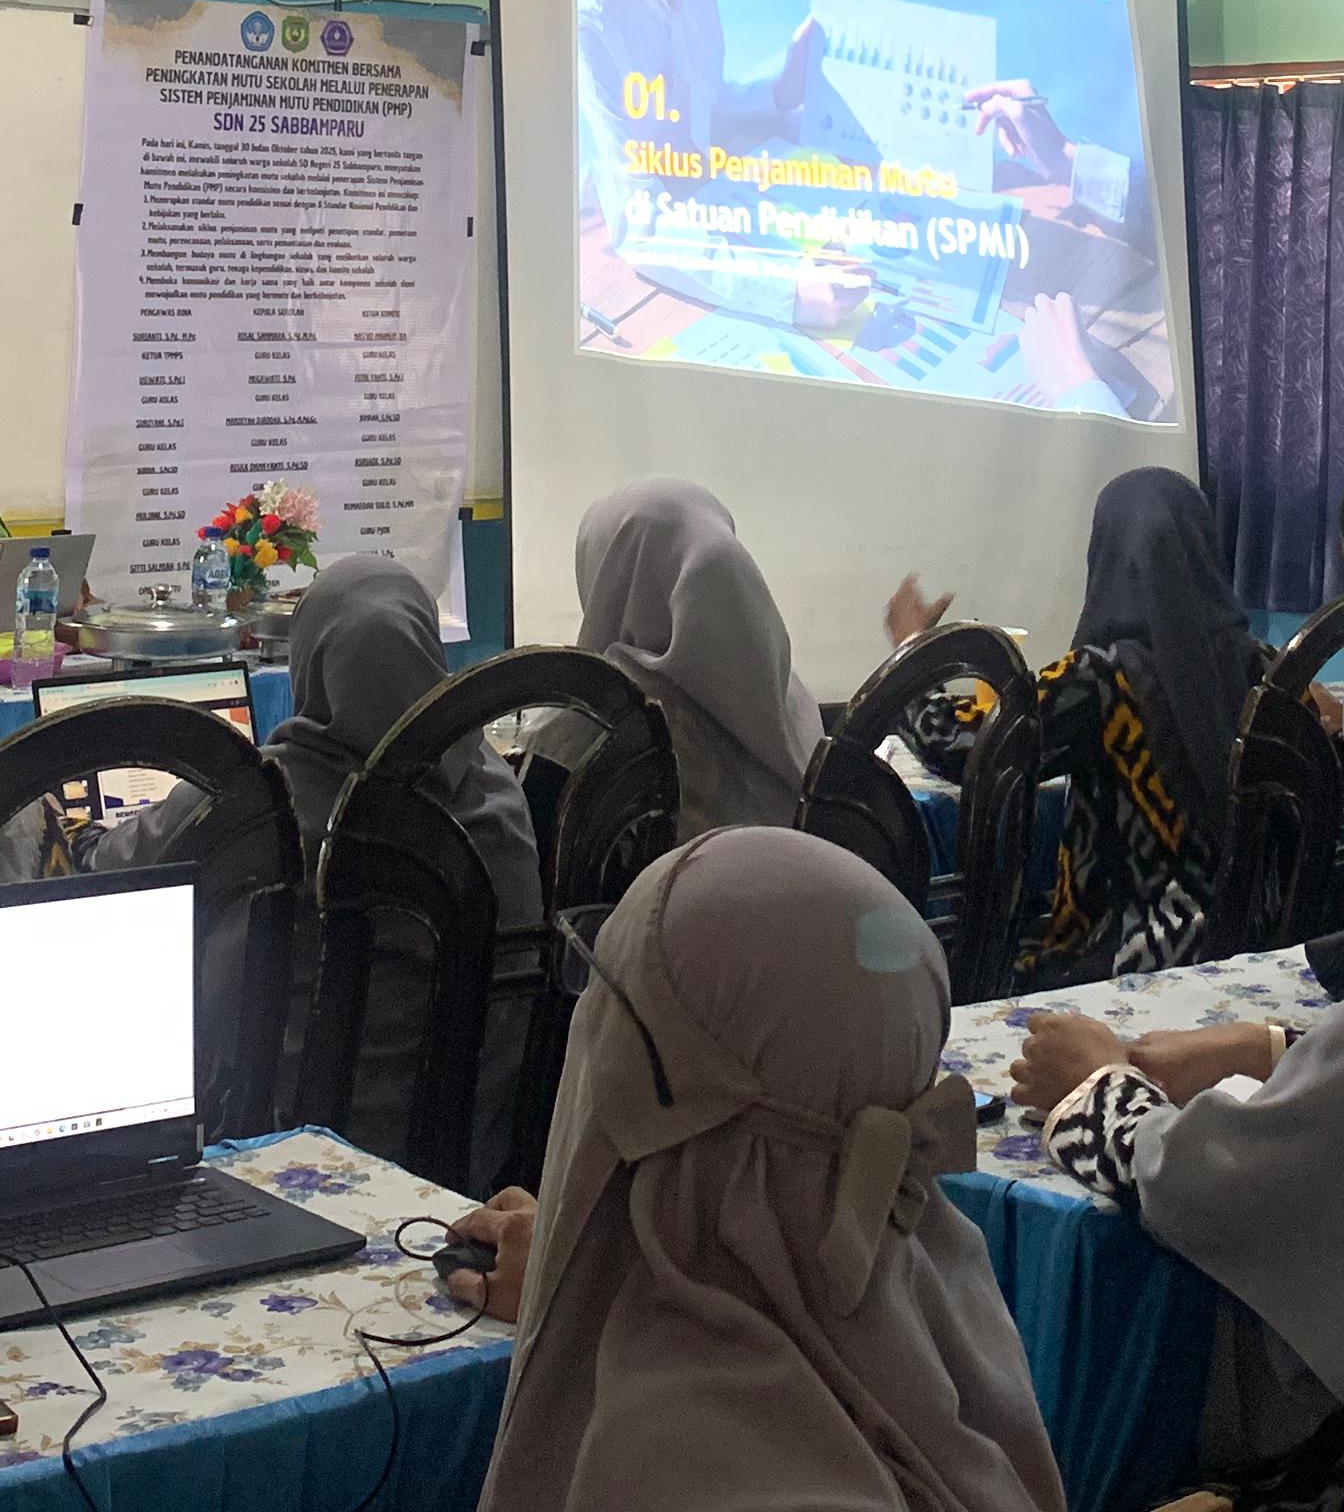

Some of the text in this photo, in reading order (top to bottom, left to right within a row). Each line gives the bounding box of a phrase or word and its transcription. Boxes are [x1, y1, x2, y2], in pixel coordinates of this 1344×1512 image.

[174, 50, 401, 78] PENANDATANGANAN KOMITMEN BERSAMA
[146, 68, 429, 99] PENINGKATAN MUTU SEKOLAH MELALUI PENERAPAN
[623, 71, 680, 124] 01.
[160, 88, 412, 118] SISTEM PENJAMINAN MUTU PENDIDIKAN (PMP)
[213, 112, 365, 138] SDN 25 SABBAMPARU
[623, 141, 703, 179] Siklus
[710, 147, 873, 193] Penjaminan
[625, 191, 652, 226] di
[657, 193, 751, 235] Satuan
[759, 200, 919, 251] Pendidikan
[926, 217, 1030, 270] (SPMI)
